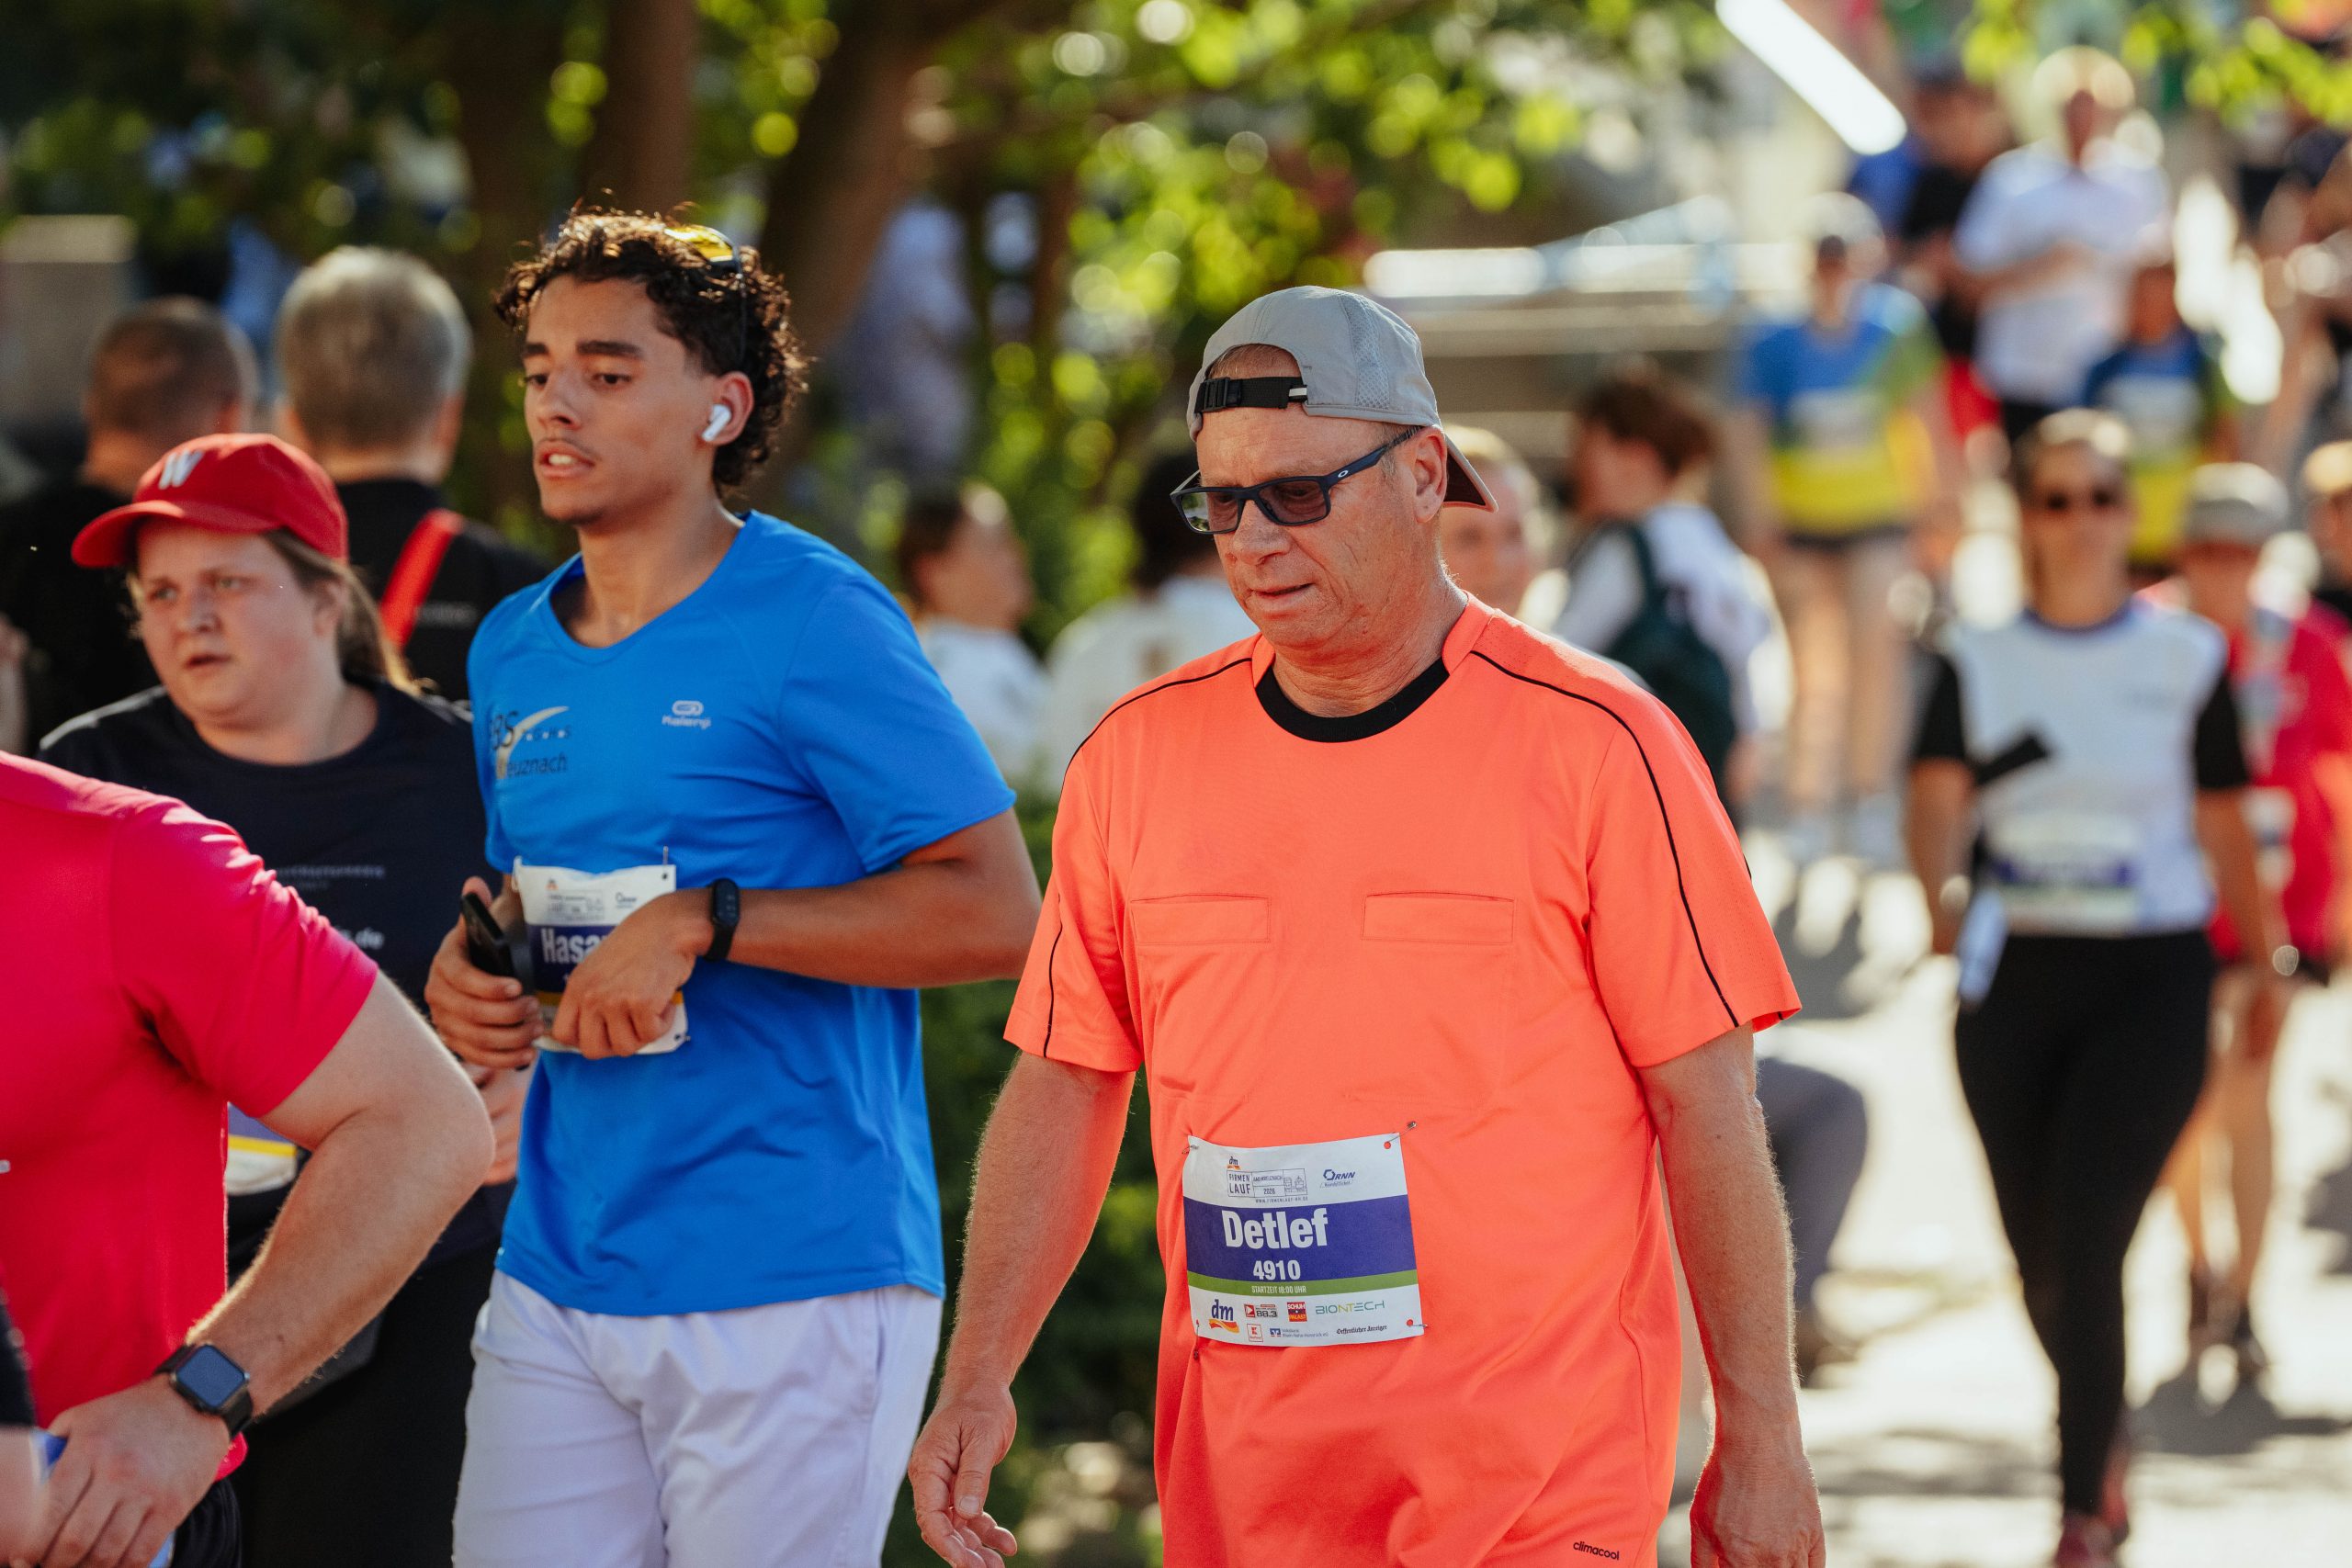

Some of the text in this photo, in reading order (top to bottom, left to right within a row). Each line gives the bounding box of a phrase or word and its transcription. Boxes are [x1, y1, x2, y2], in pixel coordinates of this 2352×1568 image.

[540, 928, 609, 964] Hasa
[1228, 1174, 1250, 1182] FIRMEN
[1229, 1183, 1250, 1194] LAUF
[1222, 1208, 1328, 1249] Detlef
[1253, 1259, 1301, 1280] 4910
[1294, 1285, 1306, 1293] UHR
[1211, 1299, 1234, 1321] dm
[1573, 1540, 1620, 1561] climacool
